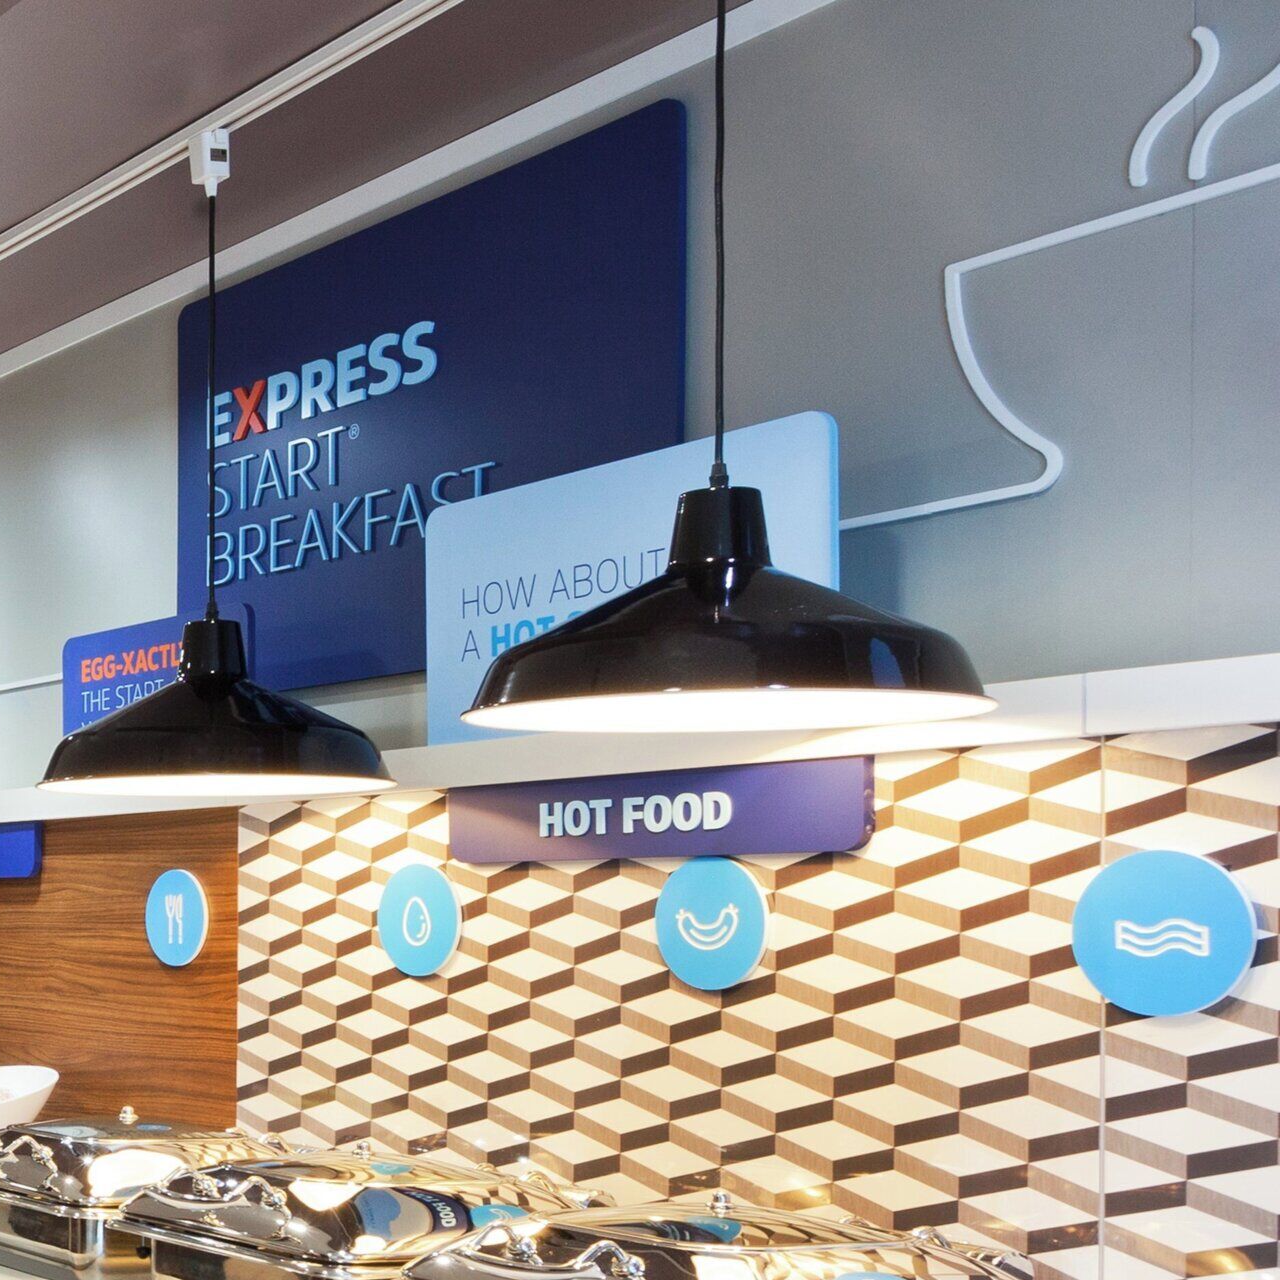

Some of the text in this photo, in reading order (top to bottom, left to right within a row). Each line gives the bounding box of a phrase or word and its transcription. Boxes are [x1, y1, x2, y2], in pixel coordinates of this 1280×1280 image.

[206, 320, 438, 450] EXPRESS
[206, 461, 496, 588] BREAKFAST
[461, 547, 666, 619] HOW ABOUT
[80, 641, 184, 683] EGG-XACTL
[461, 629, 481, 662] A
[81, 687, 111, 714] THE
[538, 791, 733, 838] HOT FOOD
